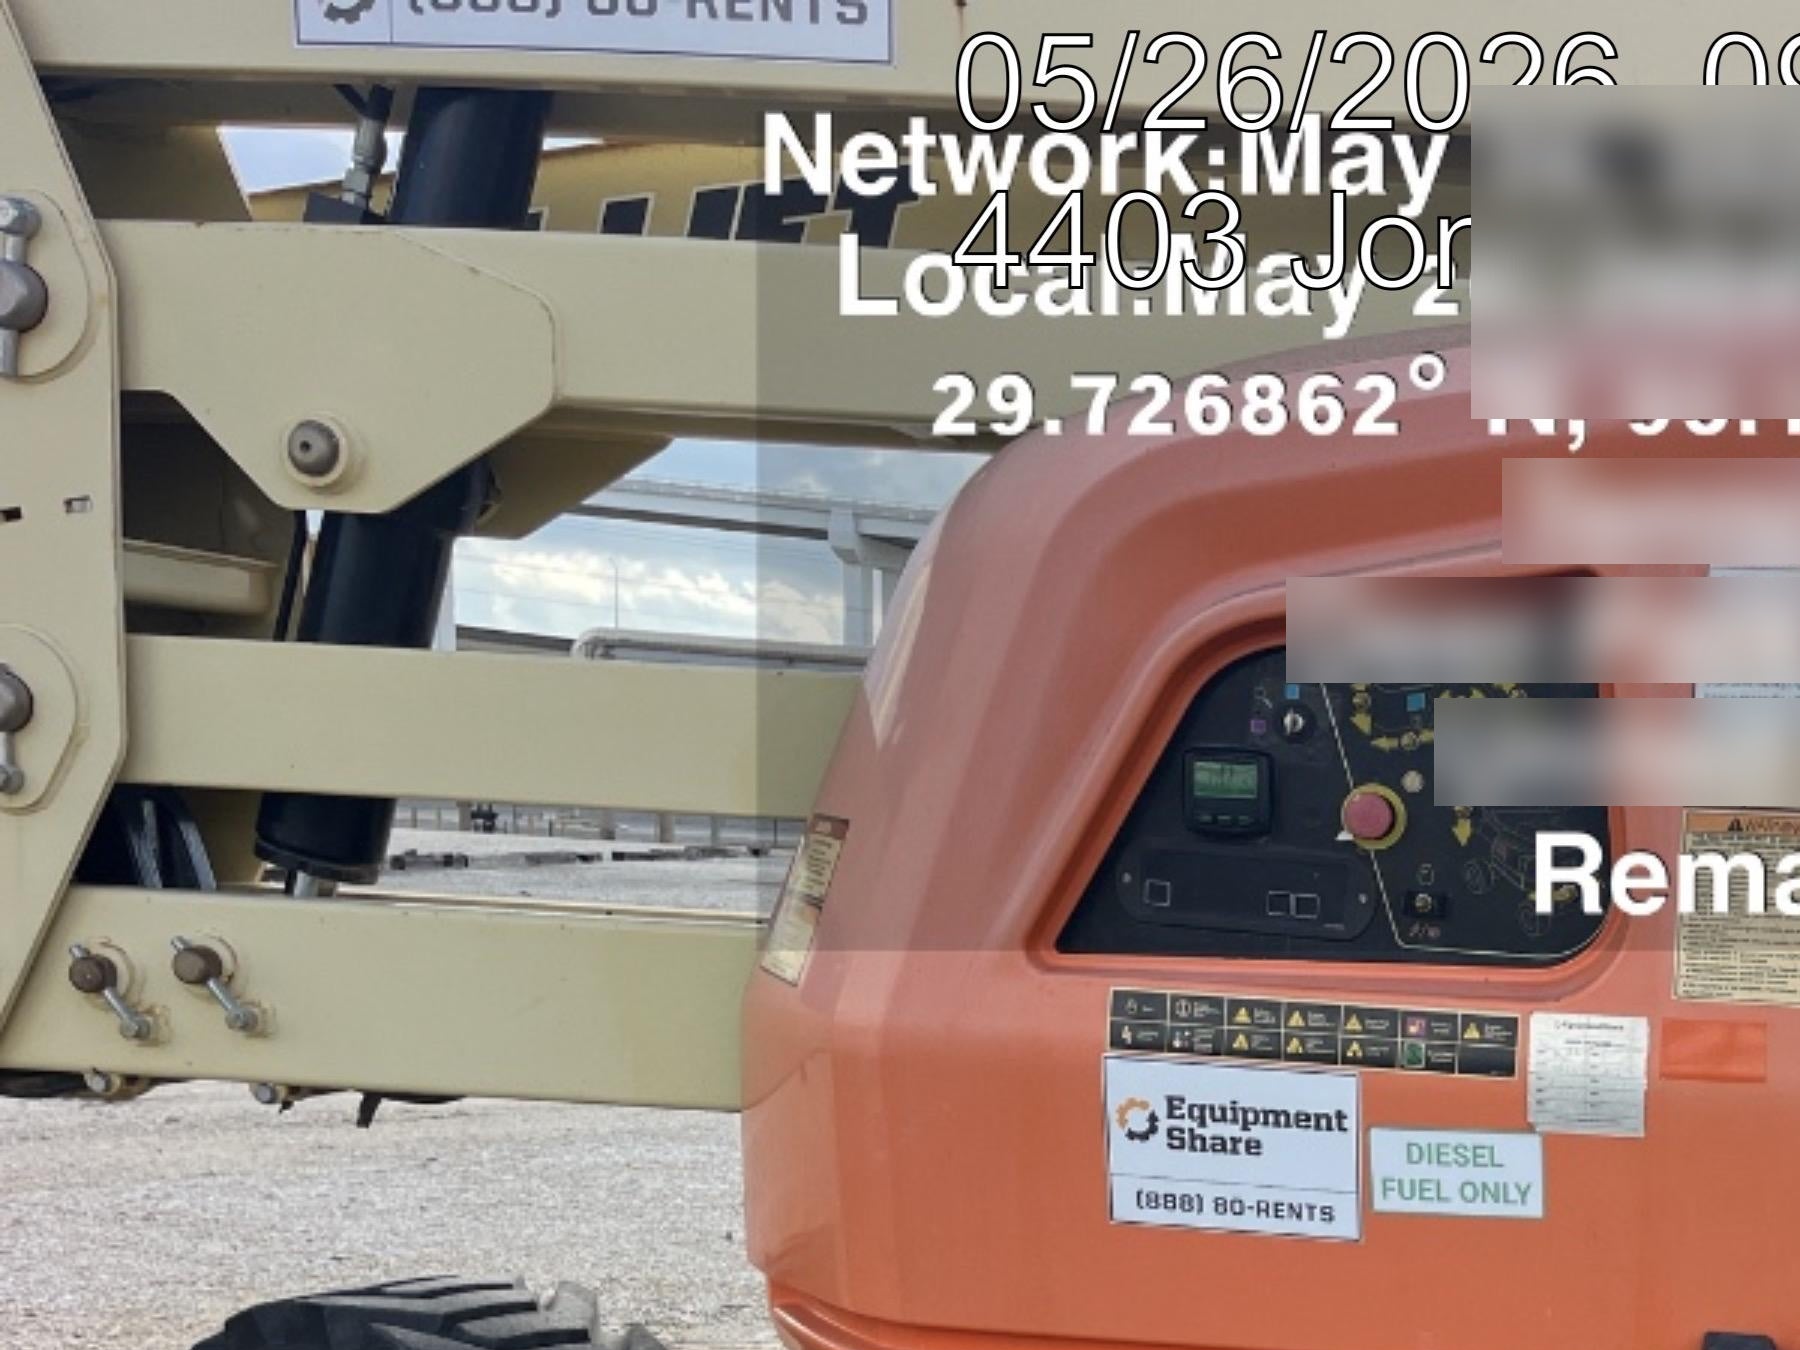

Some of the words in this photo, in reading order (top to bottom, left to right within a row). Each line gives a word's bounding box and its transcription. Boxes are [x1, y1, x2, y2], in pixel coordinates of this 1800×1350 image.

[1164, 1094, 1349, 1132] Equipment
[1165, 1126, 1263, 1157] Share
[1406, 1141, 1505, 1168] DIESEL
[1135, 1189, 1204, 1214] (888)
[1213, 1196, 1336, 1223] 80-RENTS
[1381, 1176, 1451, 1204] FUEL
[1458, 1180, 1533, 1207] ONLY
